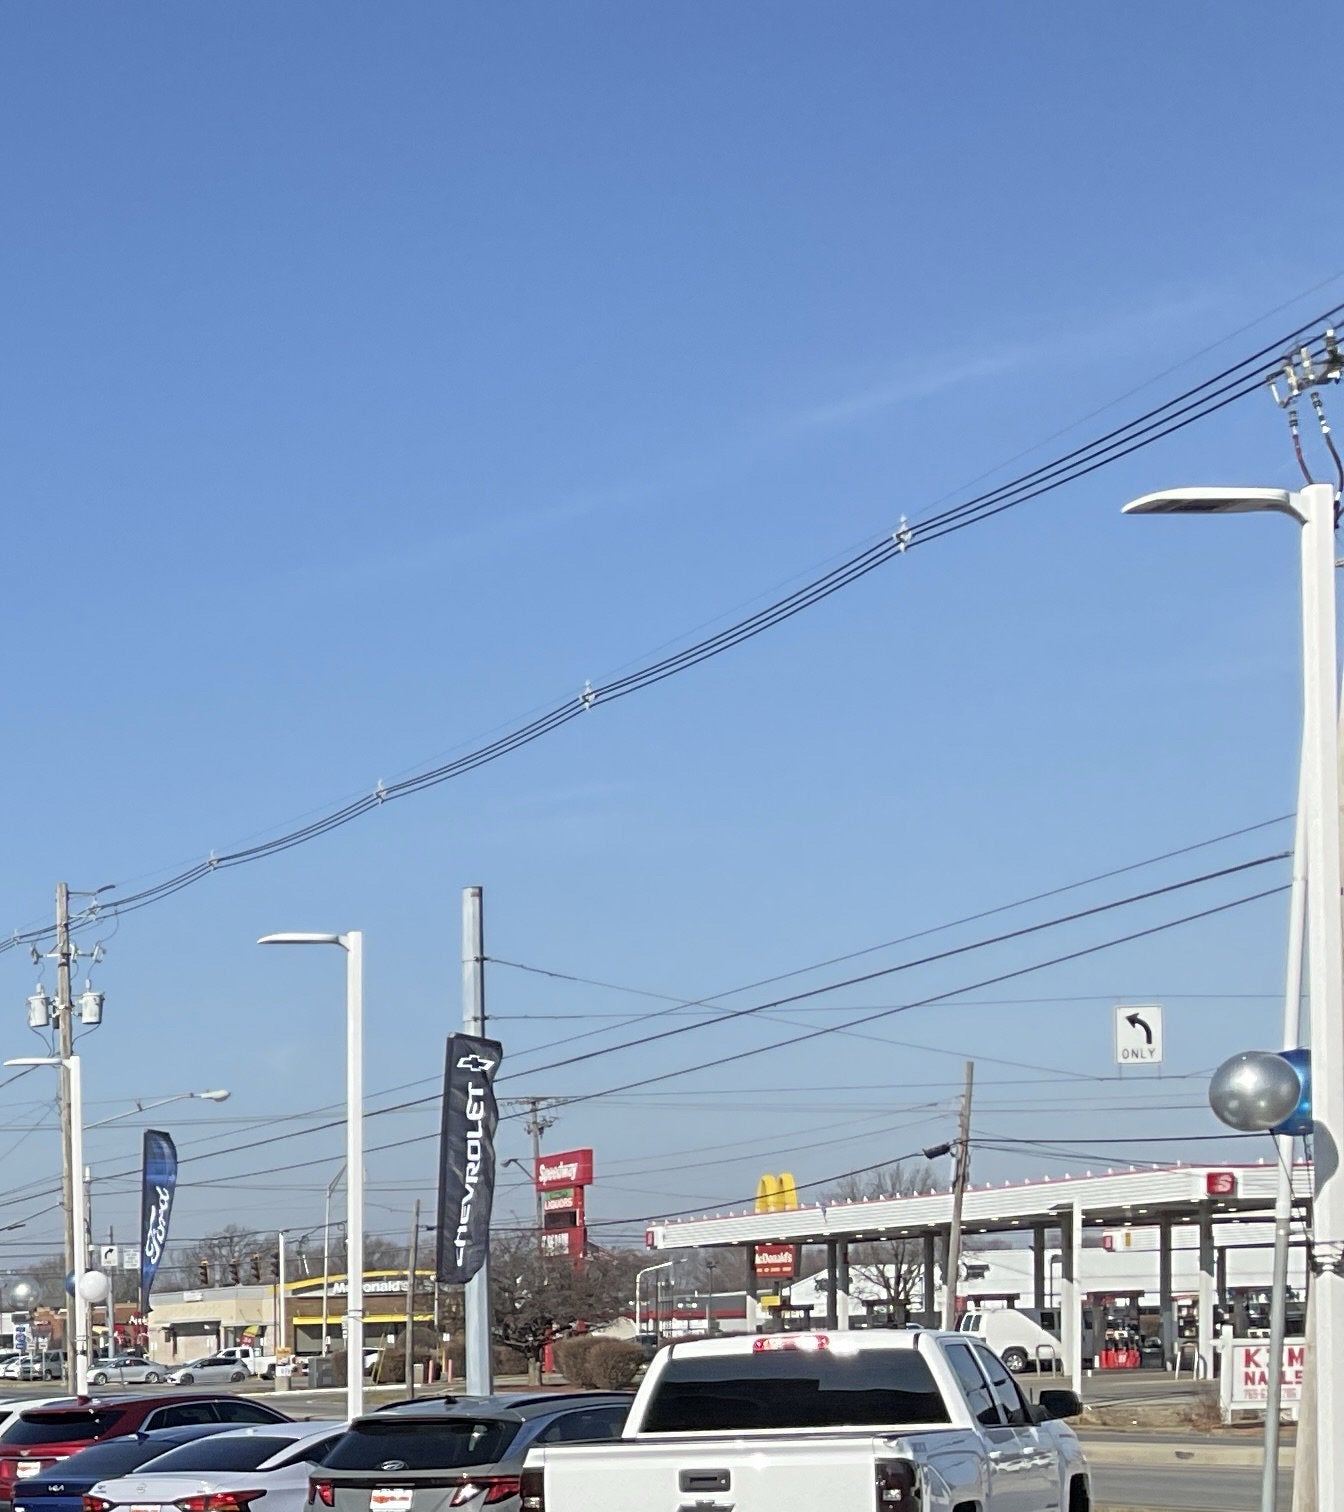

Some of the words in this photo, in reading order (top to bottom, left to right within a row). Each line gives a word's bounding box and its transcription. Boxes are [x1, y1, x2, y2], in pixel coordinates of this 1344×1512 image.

[1121, 1047, 1156, 1060] ONLY
[144, 1186, 170, 1265] Ford
[1244, 1347, 1305, 1368] KM
